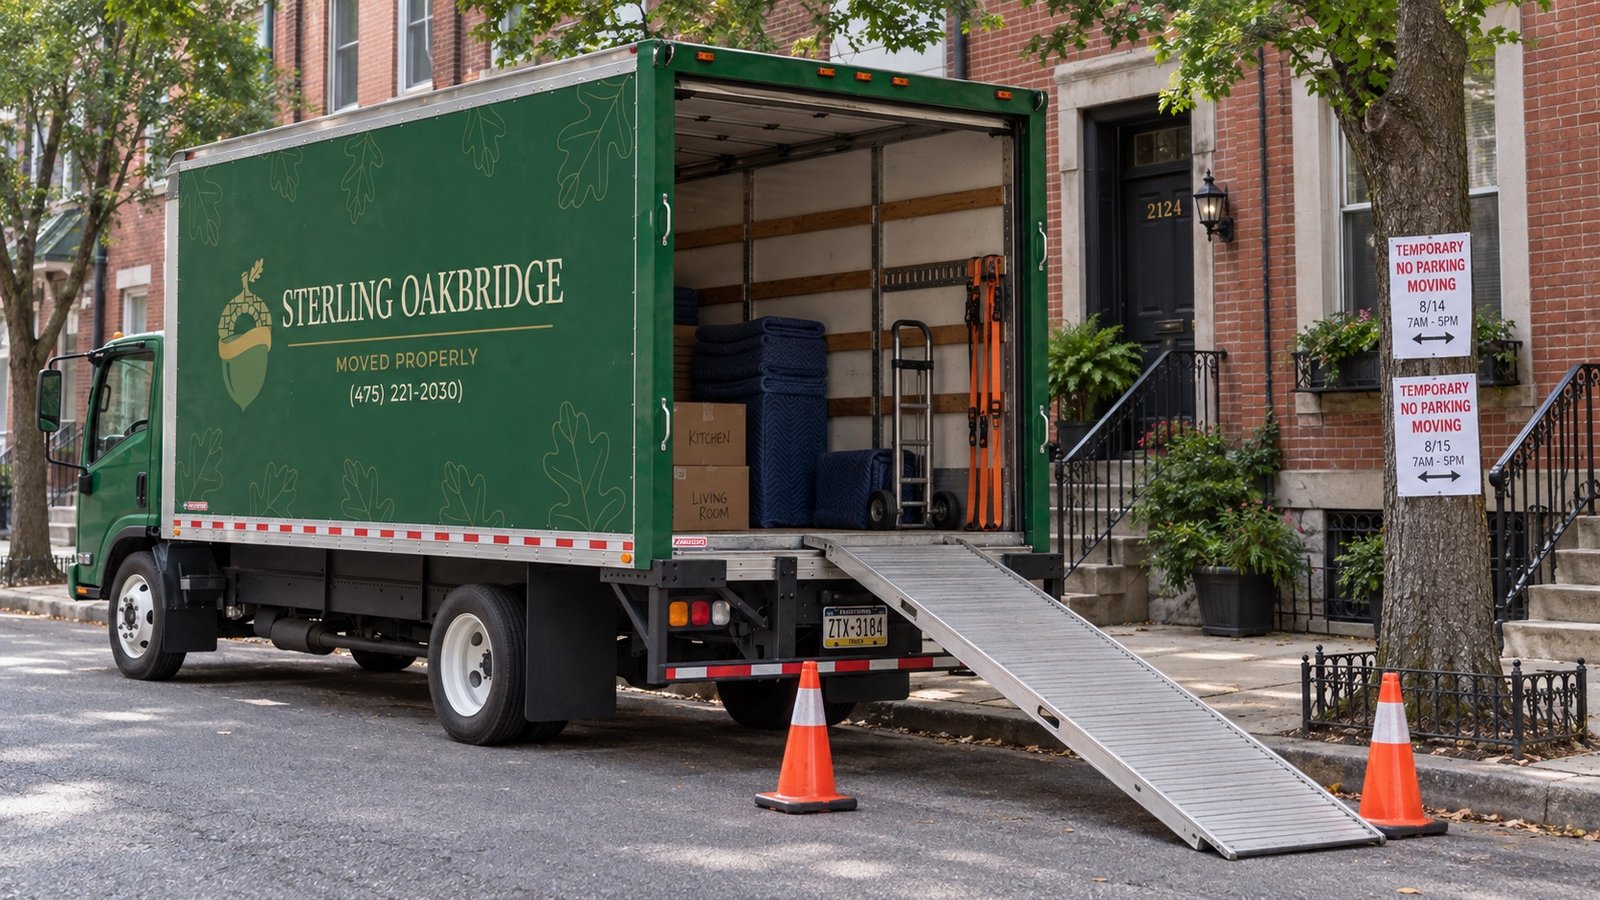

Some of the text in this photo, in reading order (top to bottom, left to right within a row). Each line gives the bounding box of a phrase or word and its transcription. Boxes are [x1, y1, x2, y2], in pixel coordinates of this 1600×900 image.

[1147, 199, 1182, 219] 2124
[1396, 241, 1464, 256] TEMPORARY
[1396, 258, 1465, 275] NO PARKING
[1408, 277, 1456, 292] MOVING
[282, 258, 564, 328] STERLING OAKBRIDGE
[1419, 300, 1445, 313] 8/14
[1408, 317, 1428, 328] 7AM
[1438, 316, 1458, 327] 5PM
[336, 348, 478, 372] MOVED PROPERLY
[350, 380, 463, 407] (475) 221-2030)
[1400, 382, 1469, 396] TEMPORARY
[1401, 399, 1471, 415] NO PARKING
[1412, 418, 1462, 433] MOVING
[688, 430, 731, 446] KITCHEN
[1425, 440, 1451, 453] 8/15
[1412, 457, 1434, 467] 7AM
[1443, 456, 1465, 466] 5PM
[692, 491, 728, 505] LIVING
[699, 506, 730, 520] ROOM
